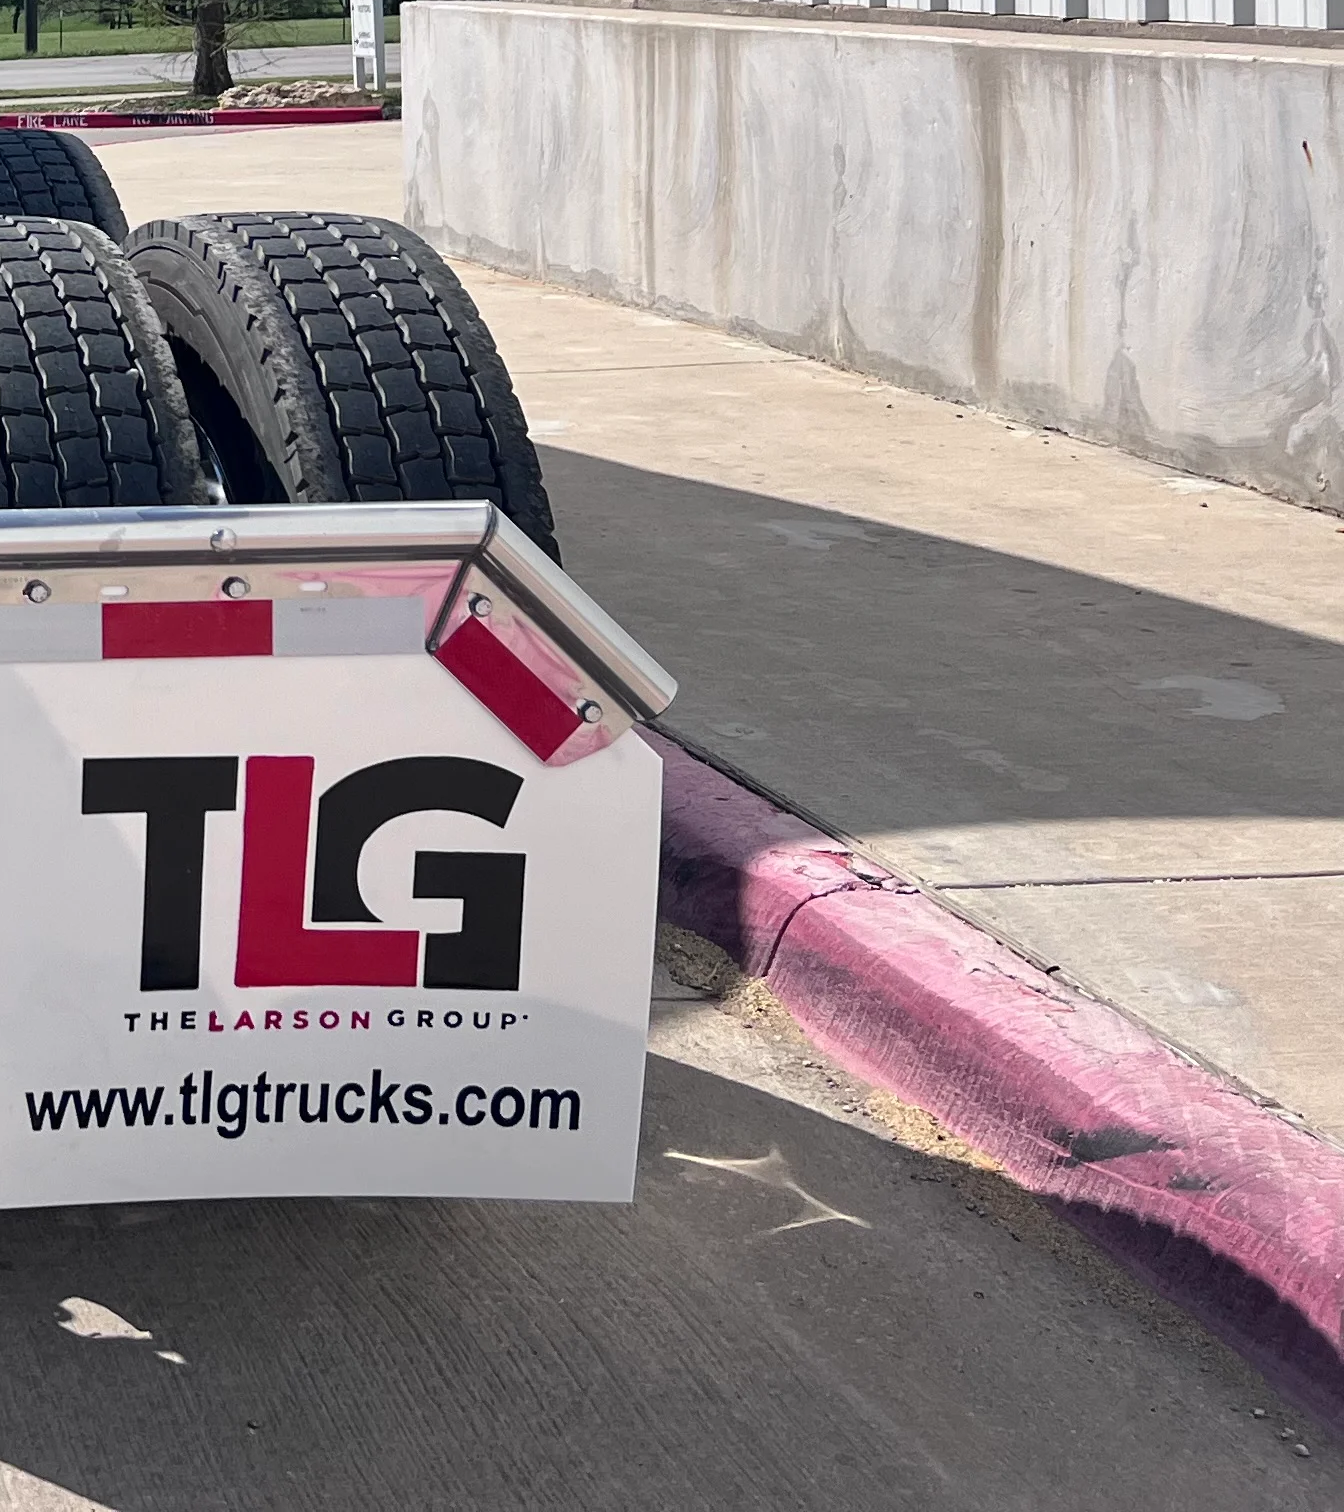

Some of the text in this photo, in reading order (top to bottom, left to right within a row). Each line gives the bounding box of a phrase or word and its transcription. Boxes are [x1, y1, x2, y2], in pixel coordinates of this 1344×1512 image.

[17, 114, 46, 129] FIRE
[53, 115, 89, 128] LANE
[81, 755, 527, 992] TLG
[123, 1008, 516, 1033] THE LARSON GROUP
[25, 1068, 581, 1140] www.tlgtrucks.com
